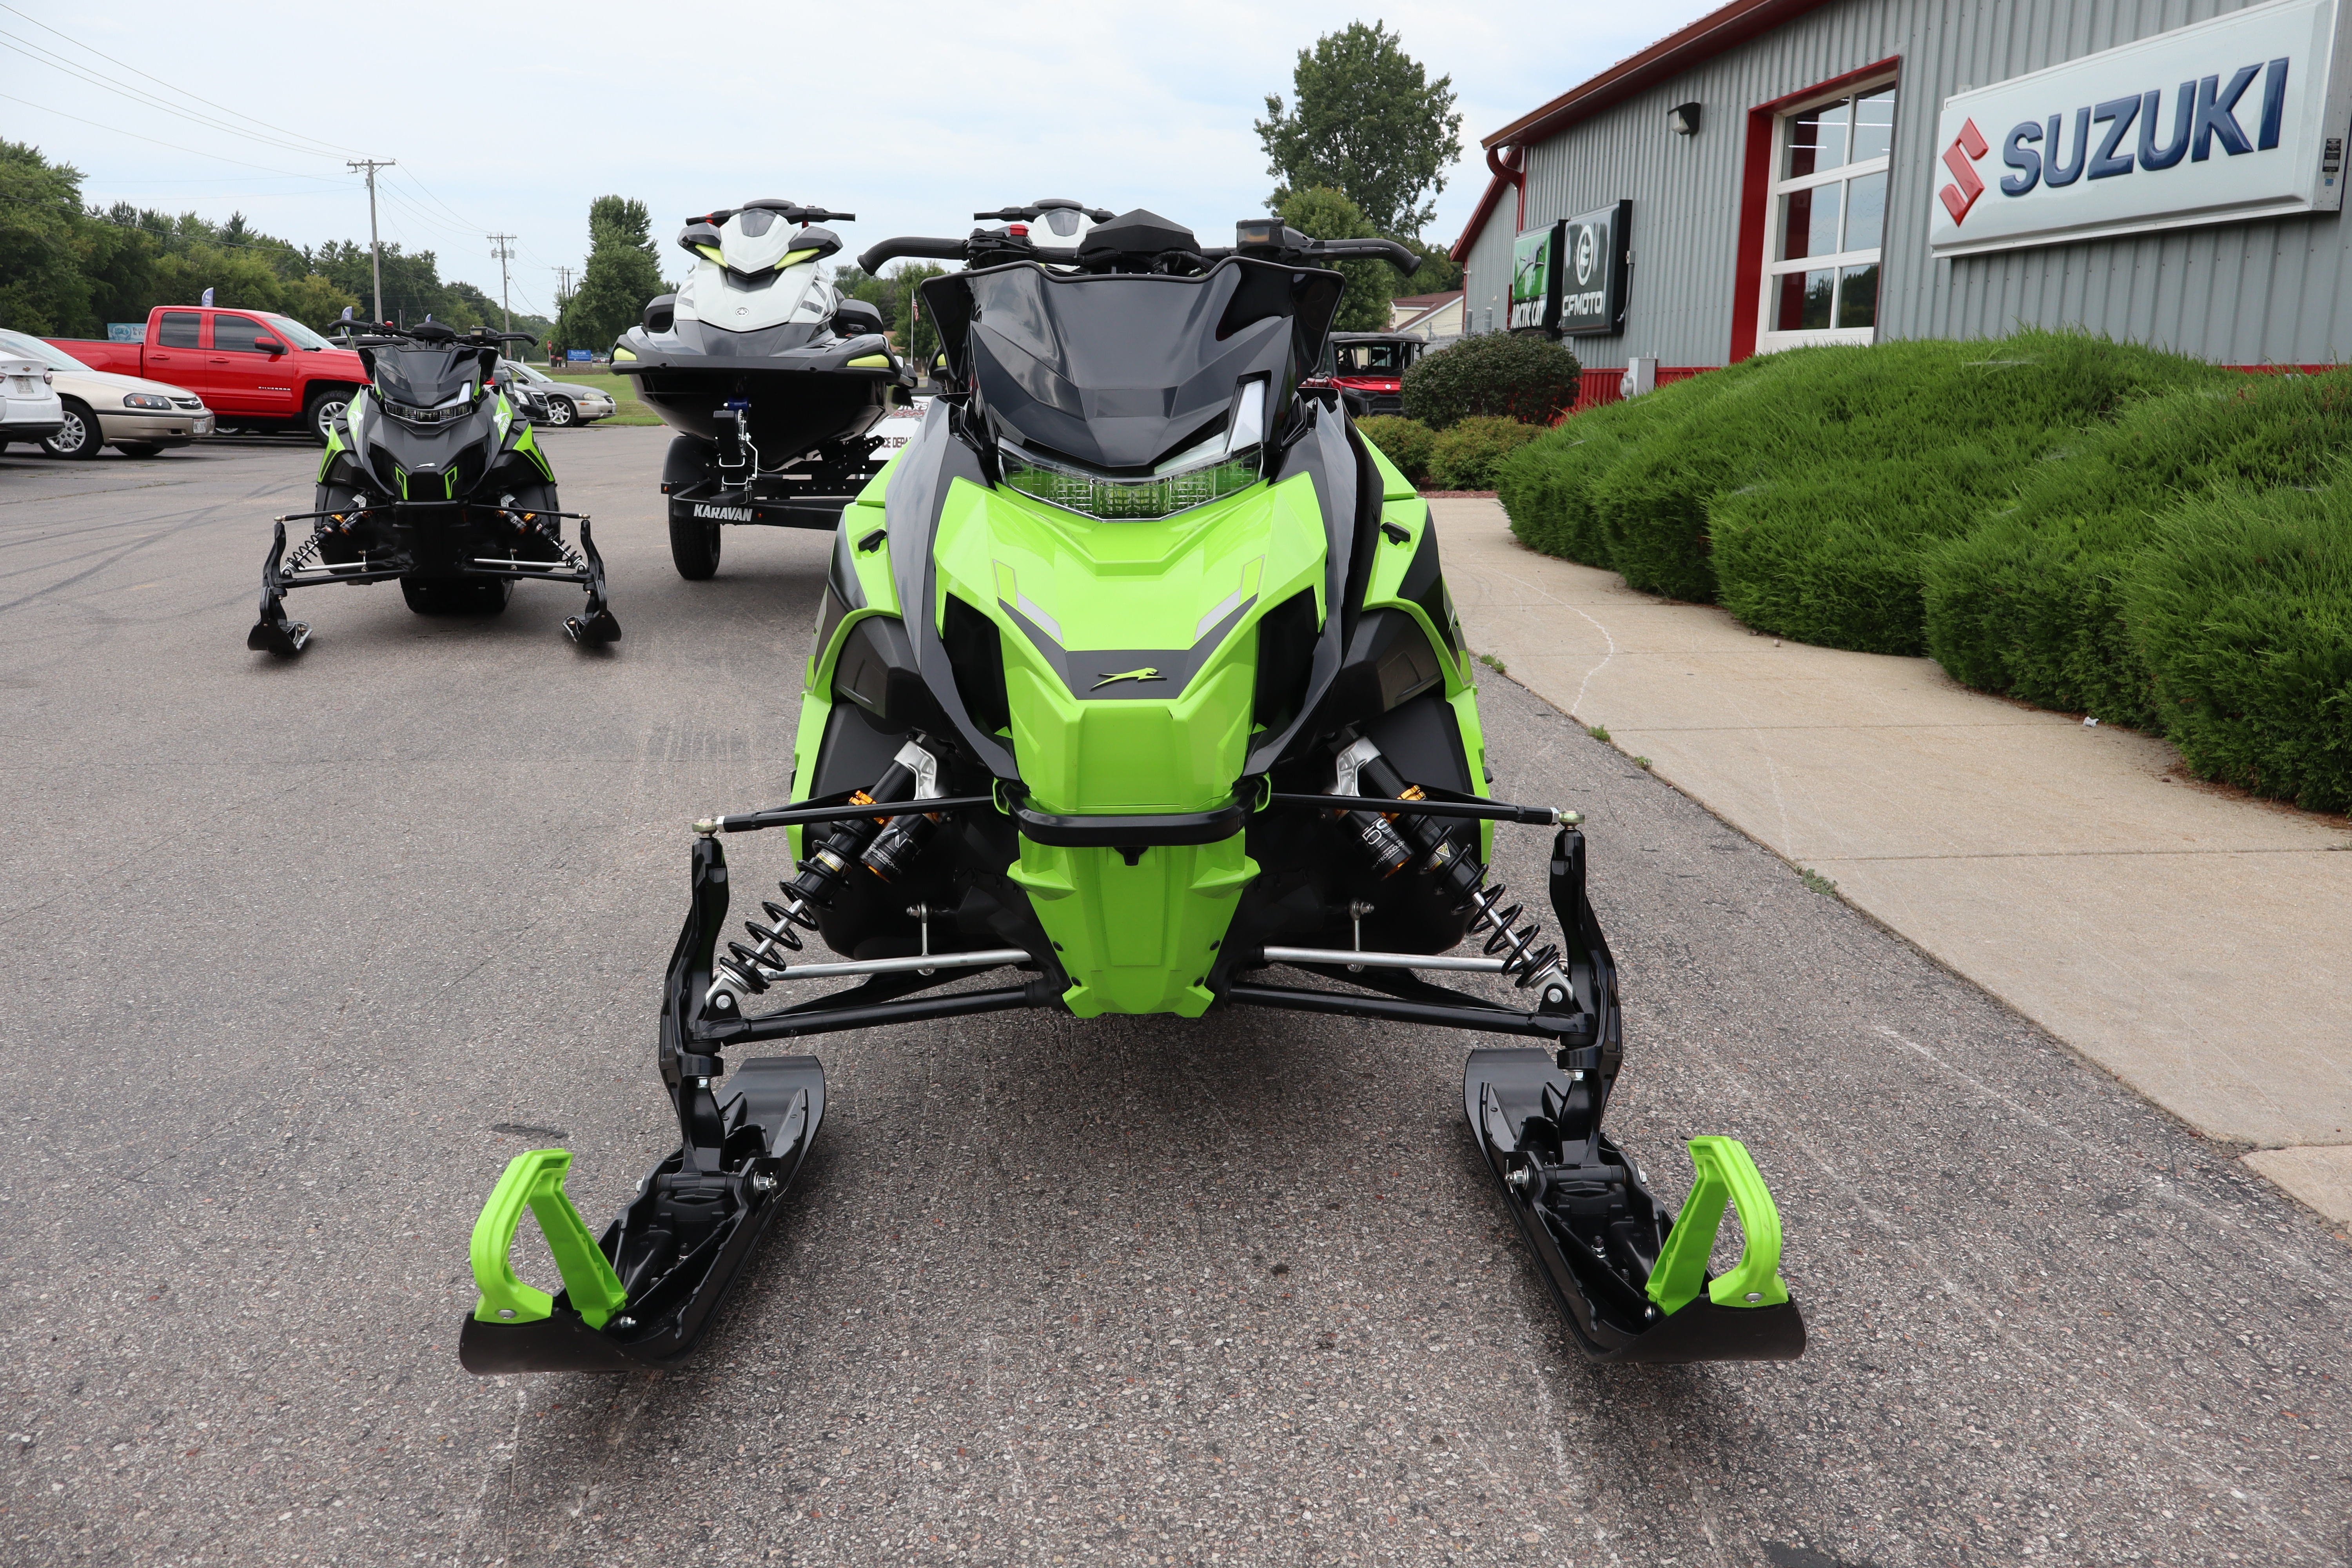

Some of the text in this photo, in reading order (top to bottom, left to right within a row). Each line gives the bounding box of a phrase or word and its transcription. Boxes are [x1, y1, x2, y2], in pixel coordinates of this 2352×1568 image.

[2000, 57, 2289, 197] SUZUKI
[1511, 300, 1545, 329] ARCTIC CAT
[1563, 291, 1603, 317] CFMOTO
[693, 504, 753, 522] KARAVAN
[869, 846, 896, 869] SUSPENSION
[1378, 840, 1405, 863] TECHNOLOGY
